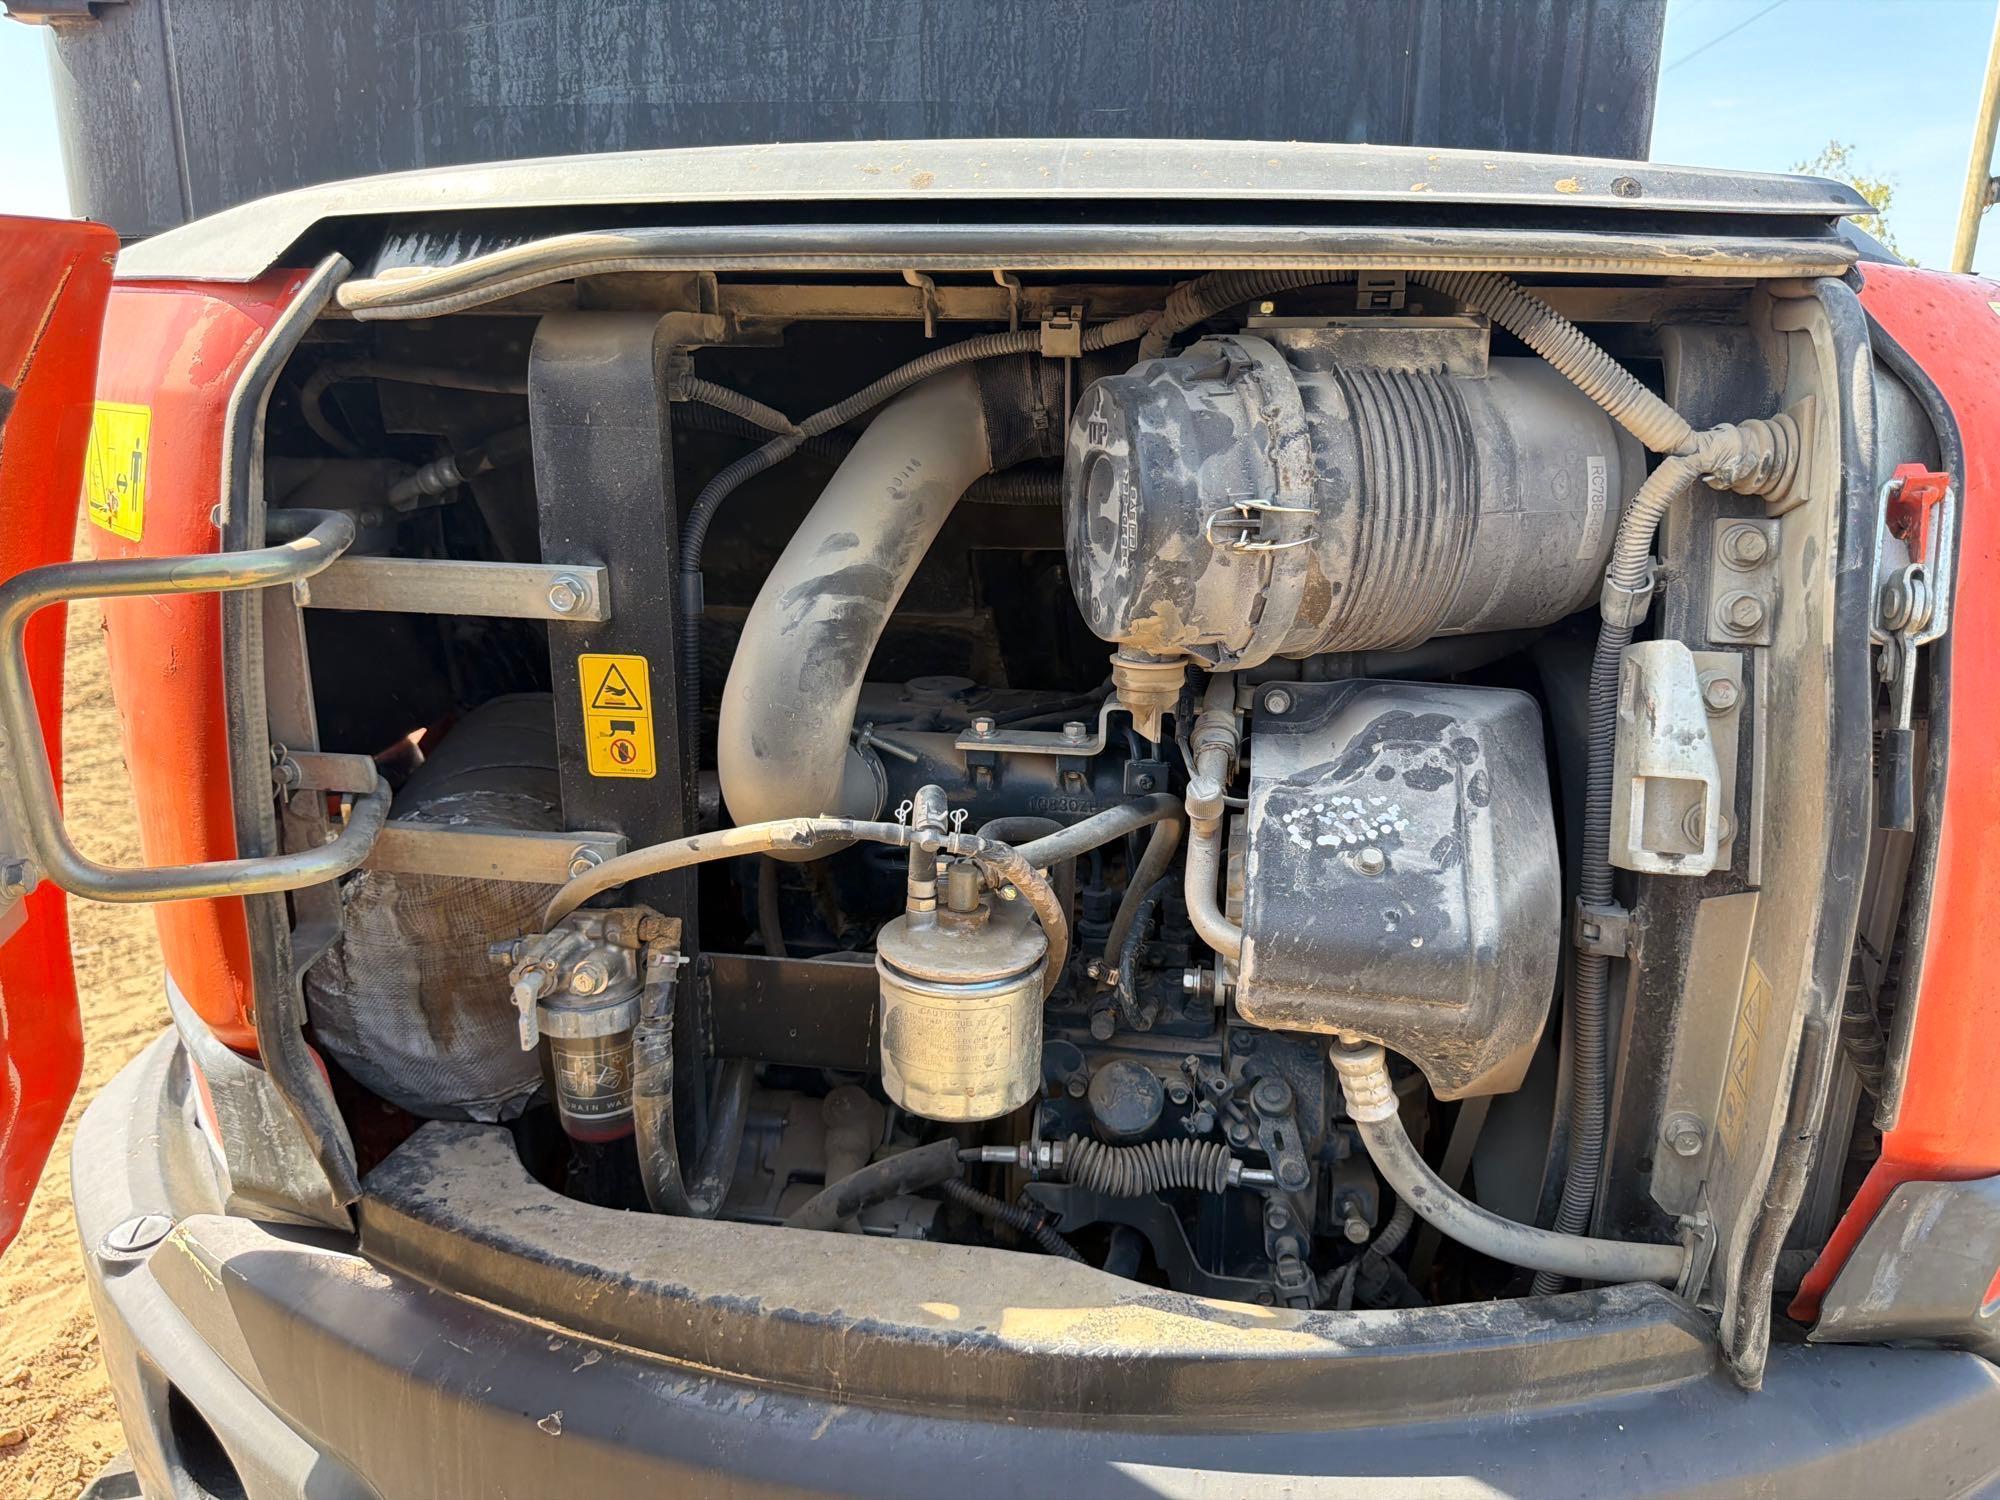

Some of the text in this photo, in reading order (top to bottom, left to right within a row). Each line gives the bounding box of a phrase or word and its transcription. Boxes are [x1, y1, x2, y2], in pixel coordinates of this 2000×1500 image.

[920, 1007, 961, 1019] CAUTION
[566, 1096, 629, 1112] DRAIN WAT
